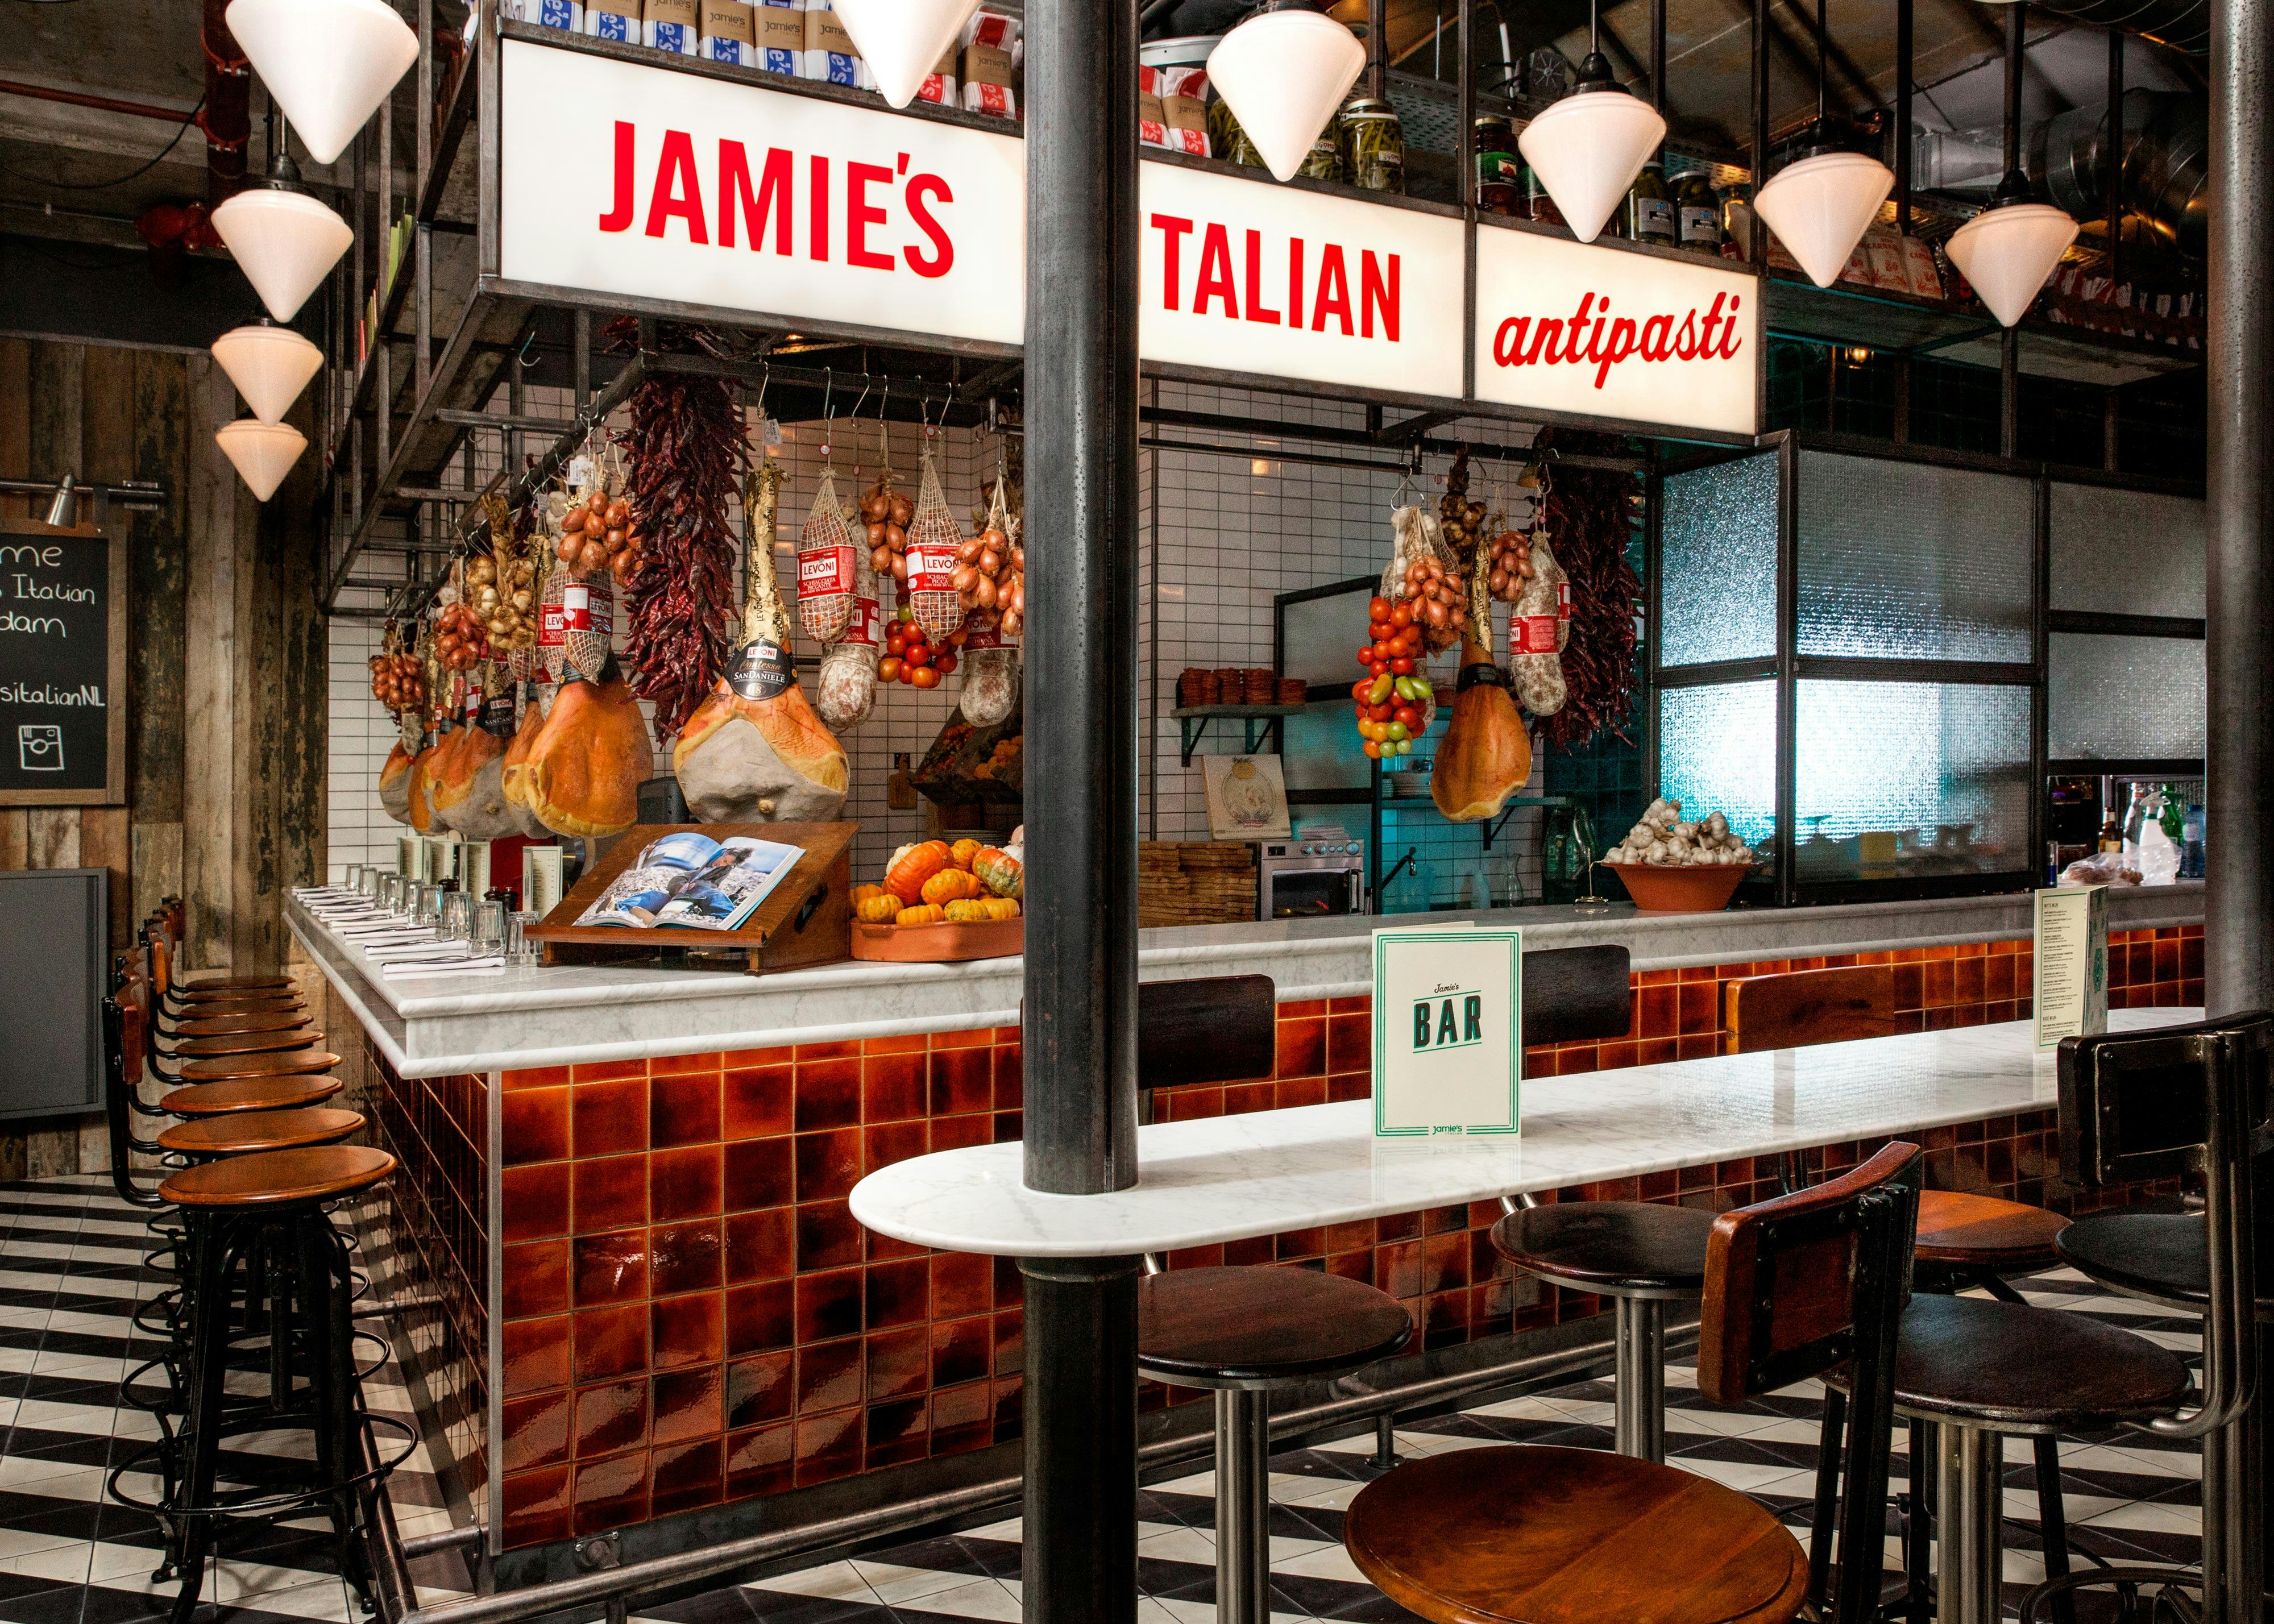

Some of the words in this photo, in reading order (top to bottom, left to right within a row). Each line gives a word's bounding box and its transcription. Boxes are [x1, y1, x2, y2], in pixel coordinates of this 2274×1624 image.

[600, 120, 954, 278] JAMIE'S
[1139, 211, 1400, 342] TALIAN
[1493, 292, 1742, 389] antipasti
[804, 562, 834, 575] LEVONI
[11, 574, 95, 605] Italian
[803, 578, 836, 587] SCHIACCIATA
[807, 583, 832, 591] PICCANTE
[1434, 983, 1459, 993] Jamie's
[1414, 995, 1482, 1049] BAR
